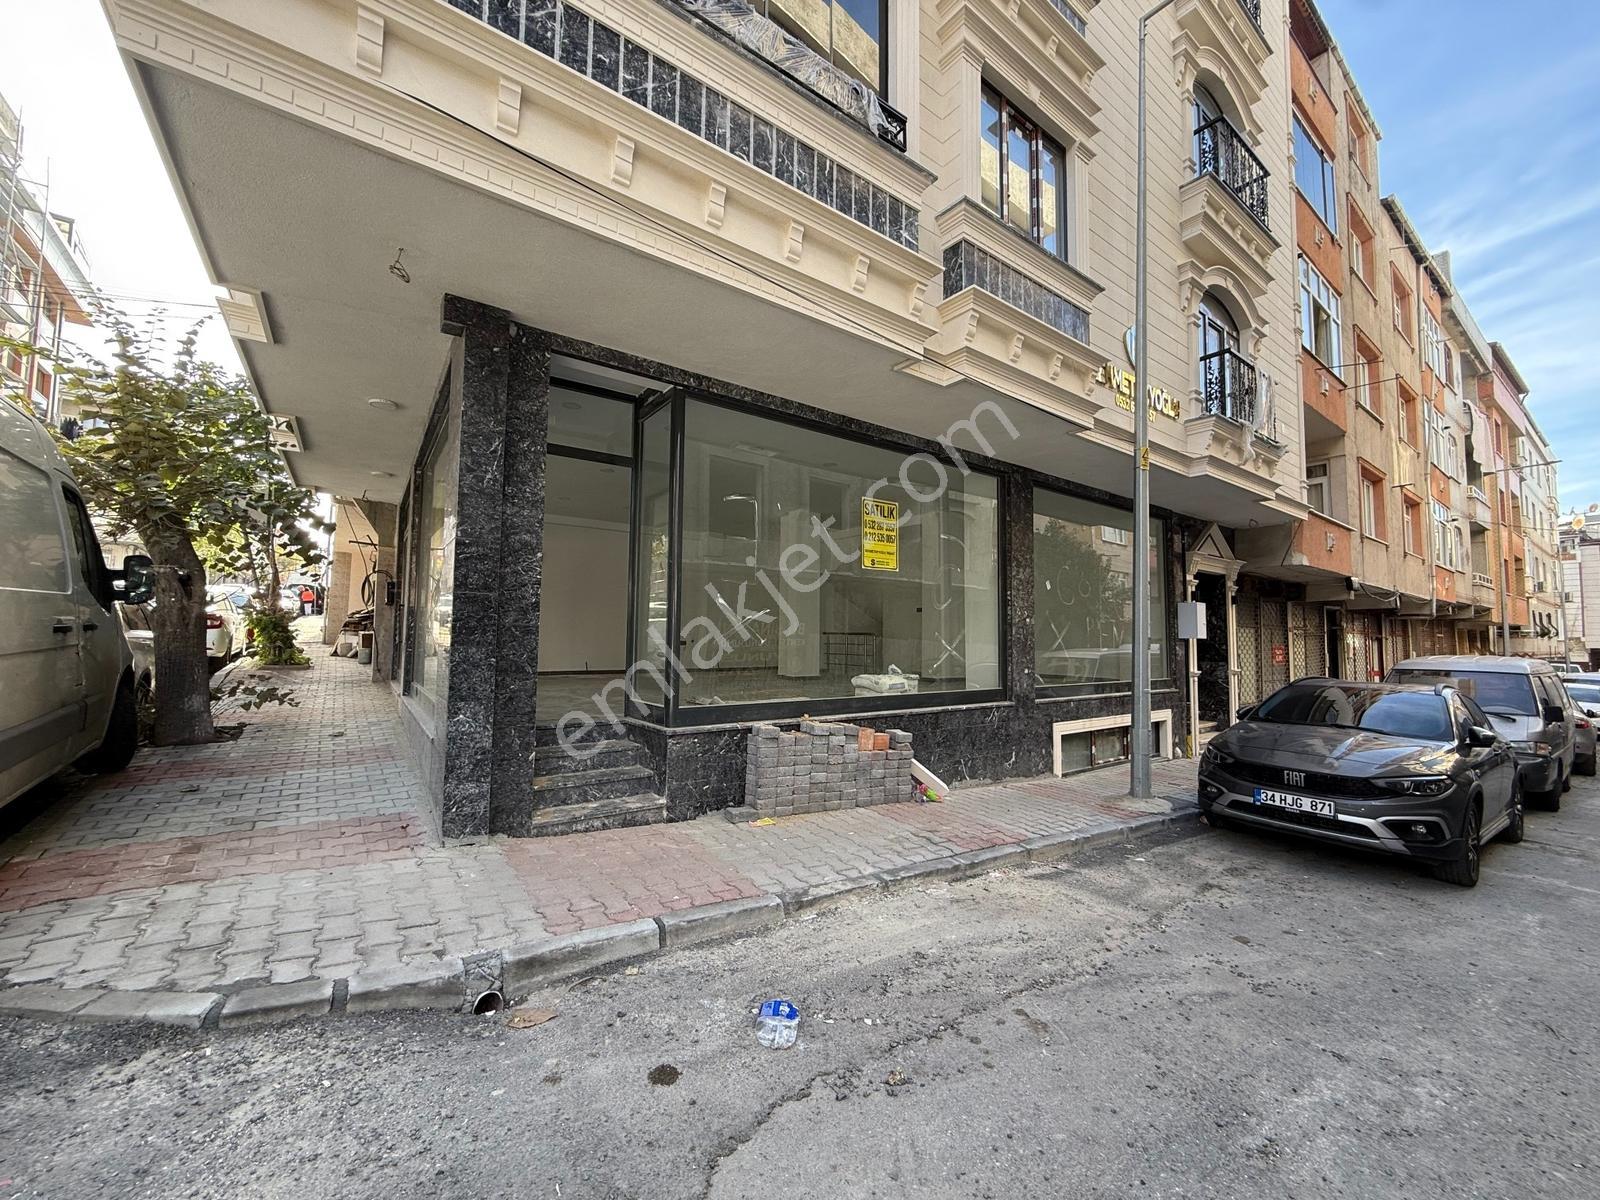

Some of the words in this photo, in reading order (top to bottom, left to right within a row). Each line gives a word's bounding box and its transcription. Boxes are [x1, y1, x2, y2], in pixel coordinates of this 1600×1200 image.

[864, 503, 896, 520] SATILIK
[1283, 770, 1306, 787] FIAT
[1261, 791, 1276, 804] 34
[1279, 794, 1303, 809] HJG
[1310, 800, 1333, 814] 871
